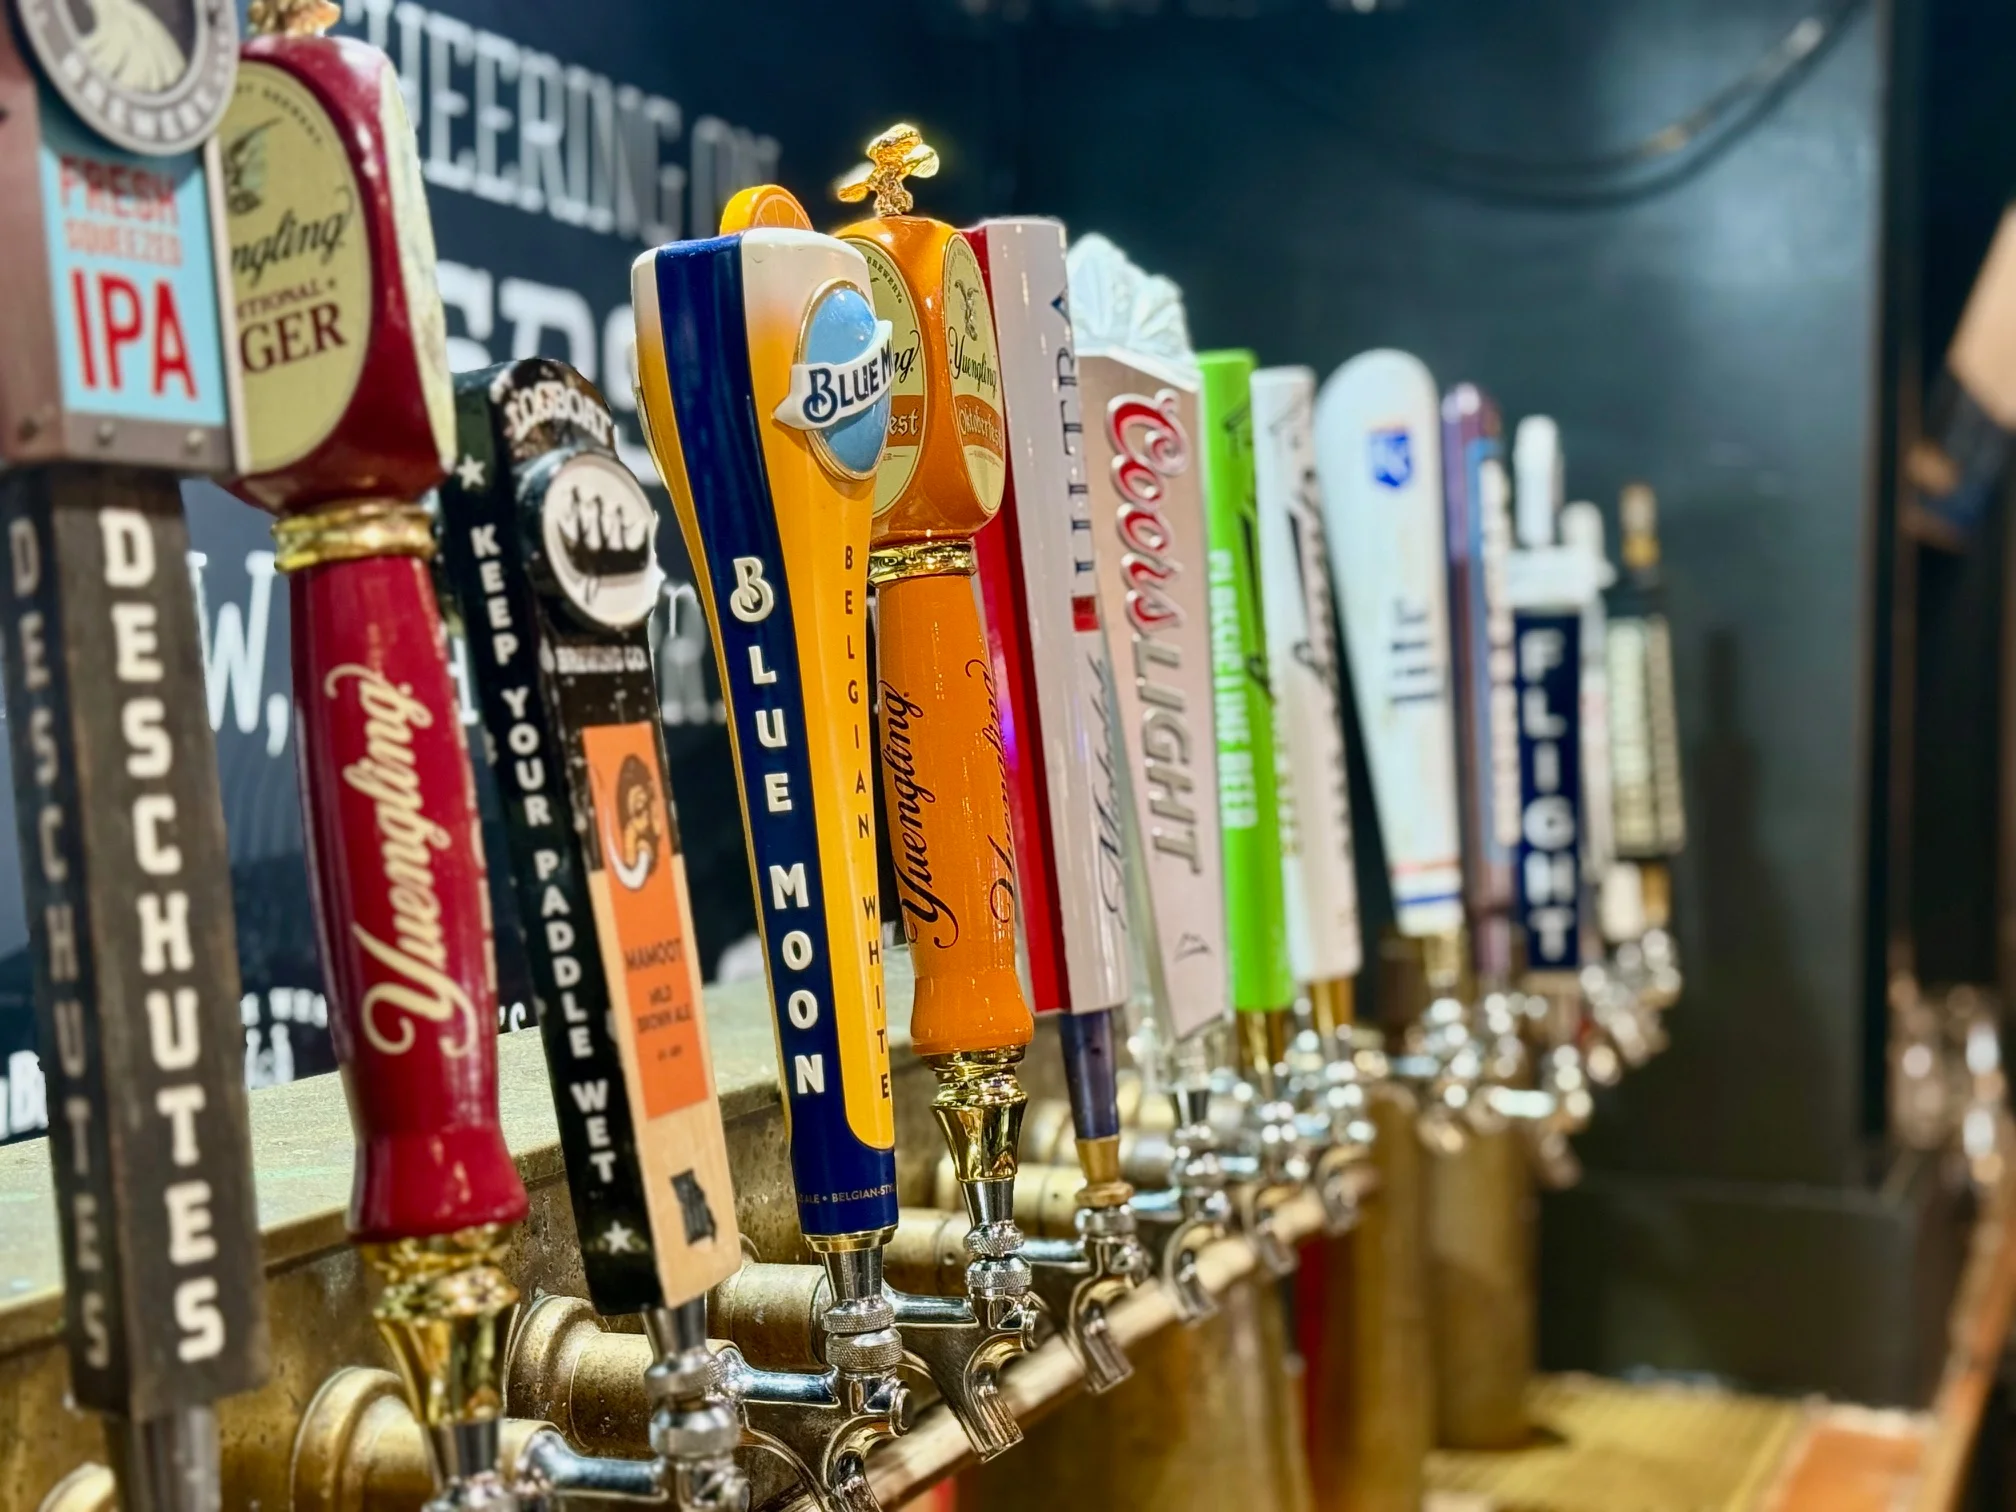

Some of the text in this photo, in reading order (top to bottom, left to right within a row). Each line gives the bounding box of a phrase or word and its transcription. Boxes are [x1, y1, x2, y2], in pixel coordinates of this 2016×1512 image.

[231, 186, 355, 288] ngling
[347, 0, 686, 247] HEERING
[69, 267, 198, 402] IPA
[239, 302, 347, 376] GER
[503, 380, 614, 447] LOGBOAT
[802, 358, 881, 423] BLUE
[948, 326, 998, 399] Yuengling
[1105, 389, 1205, 876] Coors LIGHT
[98, 507, 226, 1363] DESCHUTES
[324, 662, 479, 1060] Yuengling
[470, 523, 520, 667] KEEP
[501, 687, 552, 827] YOUR
[535, 850, 595, 1060] PADDLE
[570, 1078, 617, 1184] WET
[730, 556, 826, 1095] BLUE MOON
[843, 545, 890, 1100] BELGIAN WHITE
[879, 680, 959, 949] Yuengling
[831, 1183, 896, 1203] BELGIAN-STY
